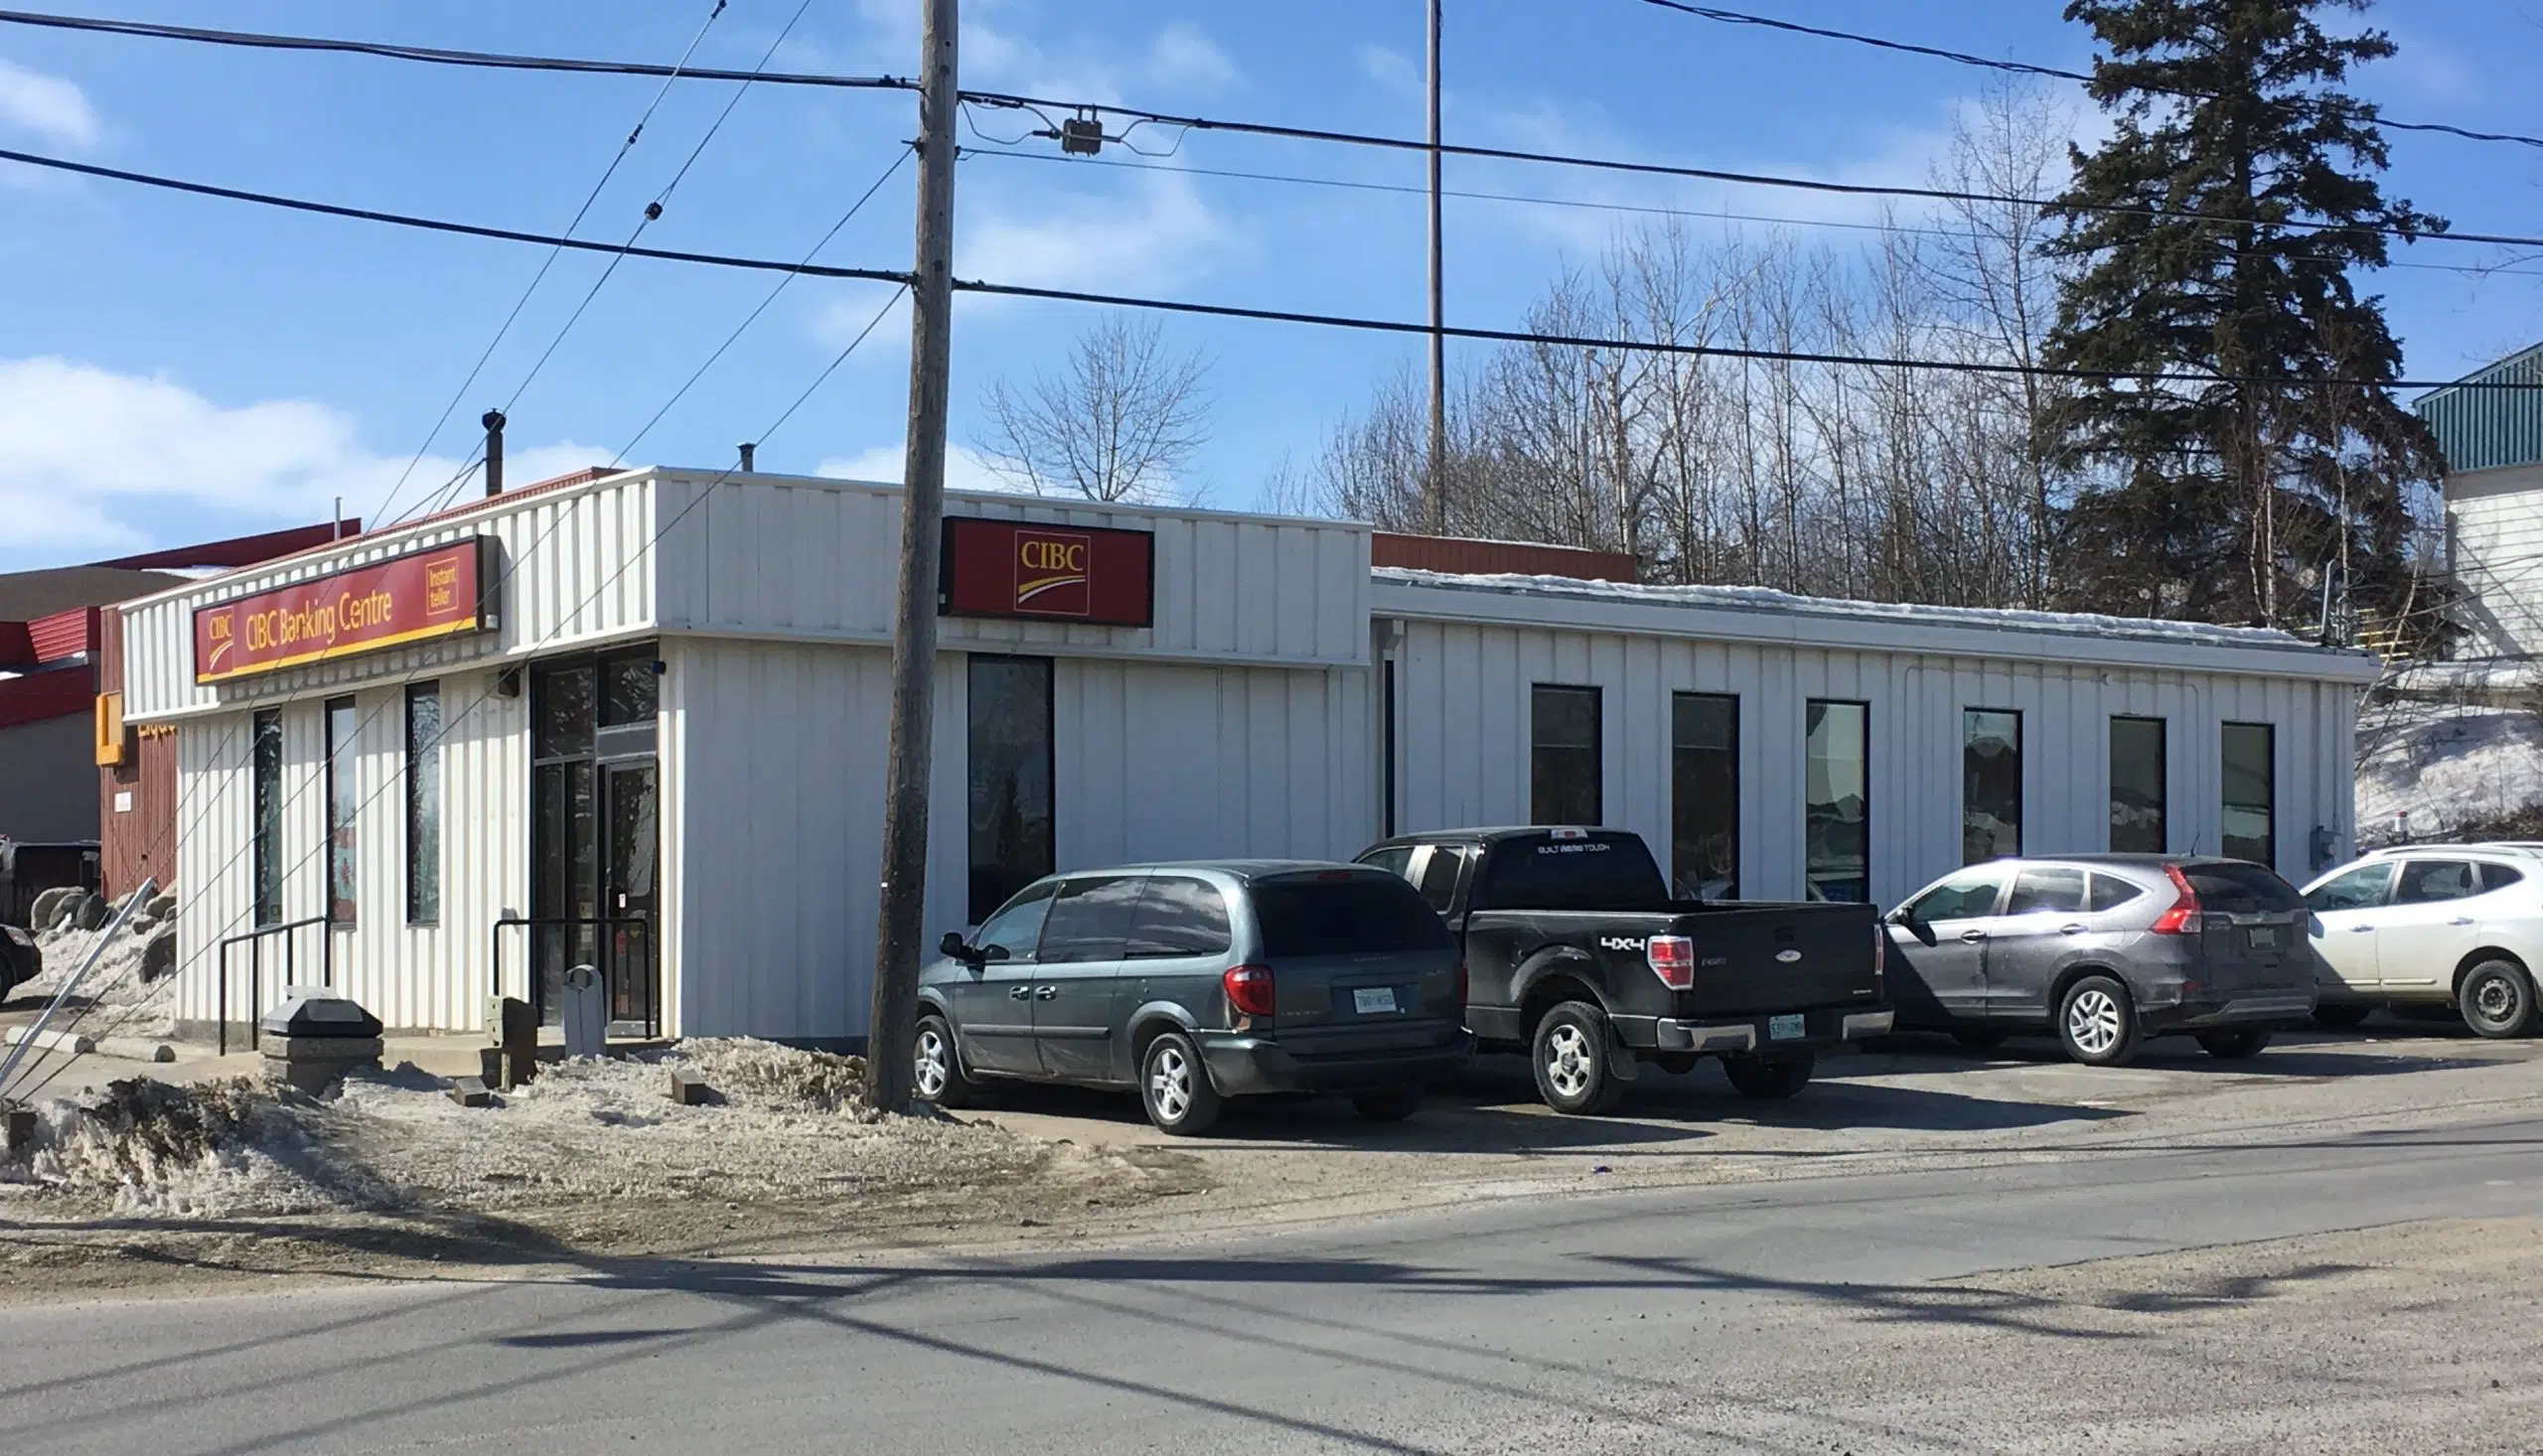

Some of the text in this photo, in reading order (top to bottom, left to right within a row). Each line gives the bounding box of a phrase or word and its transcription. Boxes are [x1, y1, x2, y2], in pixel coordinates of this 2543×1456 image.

[1020, 540, 1085, 572] CIBC
[429, 565, 457, 588] Instant
[429, 588, 451, 608] teller
[209, 614, 233, 641] CIBC
[245, 589, 392, 652] CIBC Banking Centre
